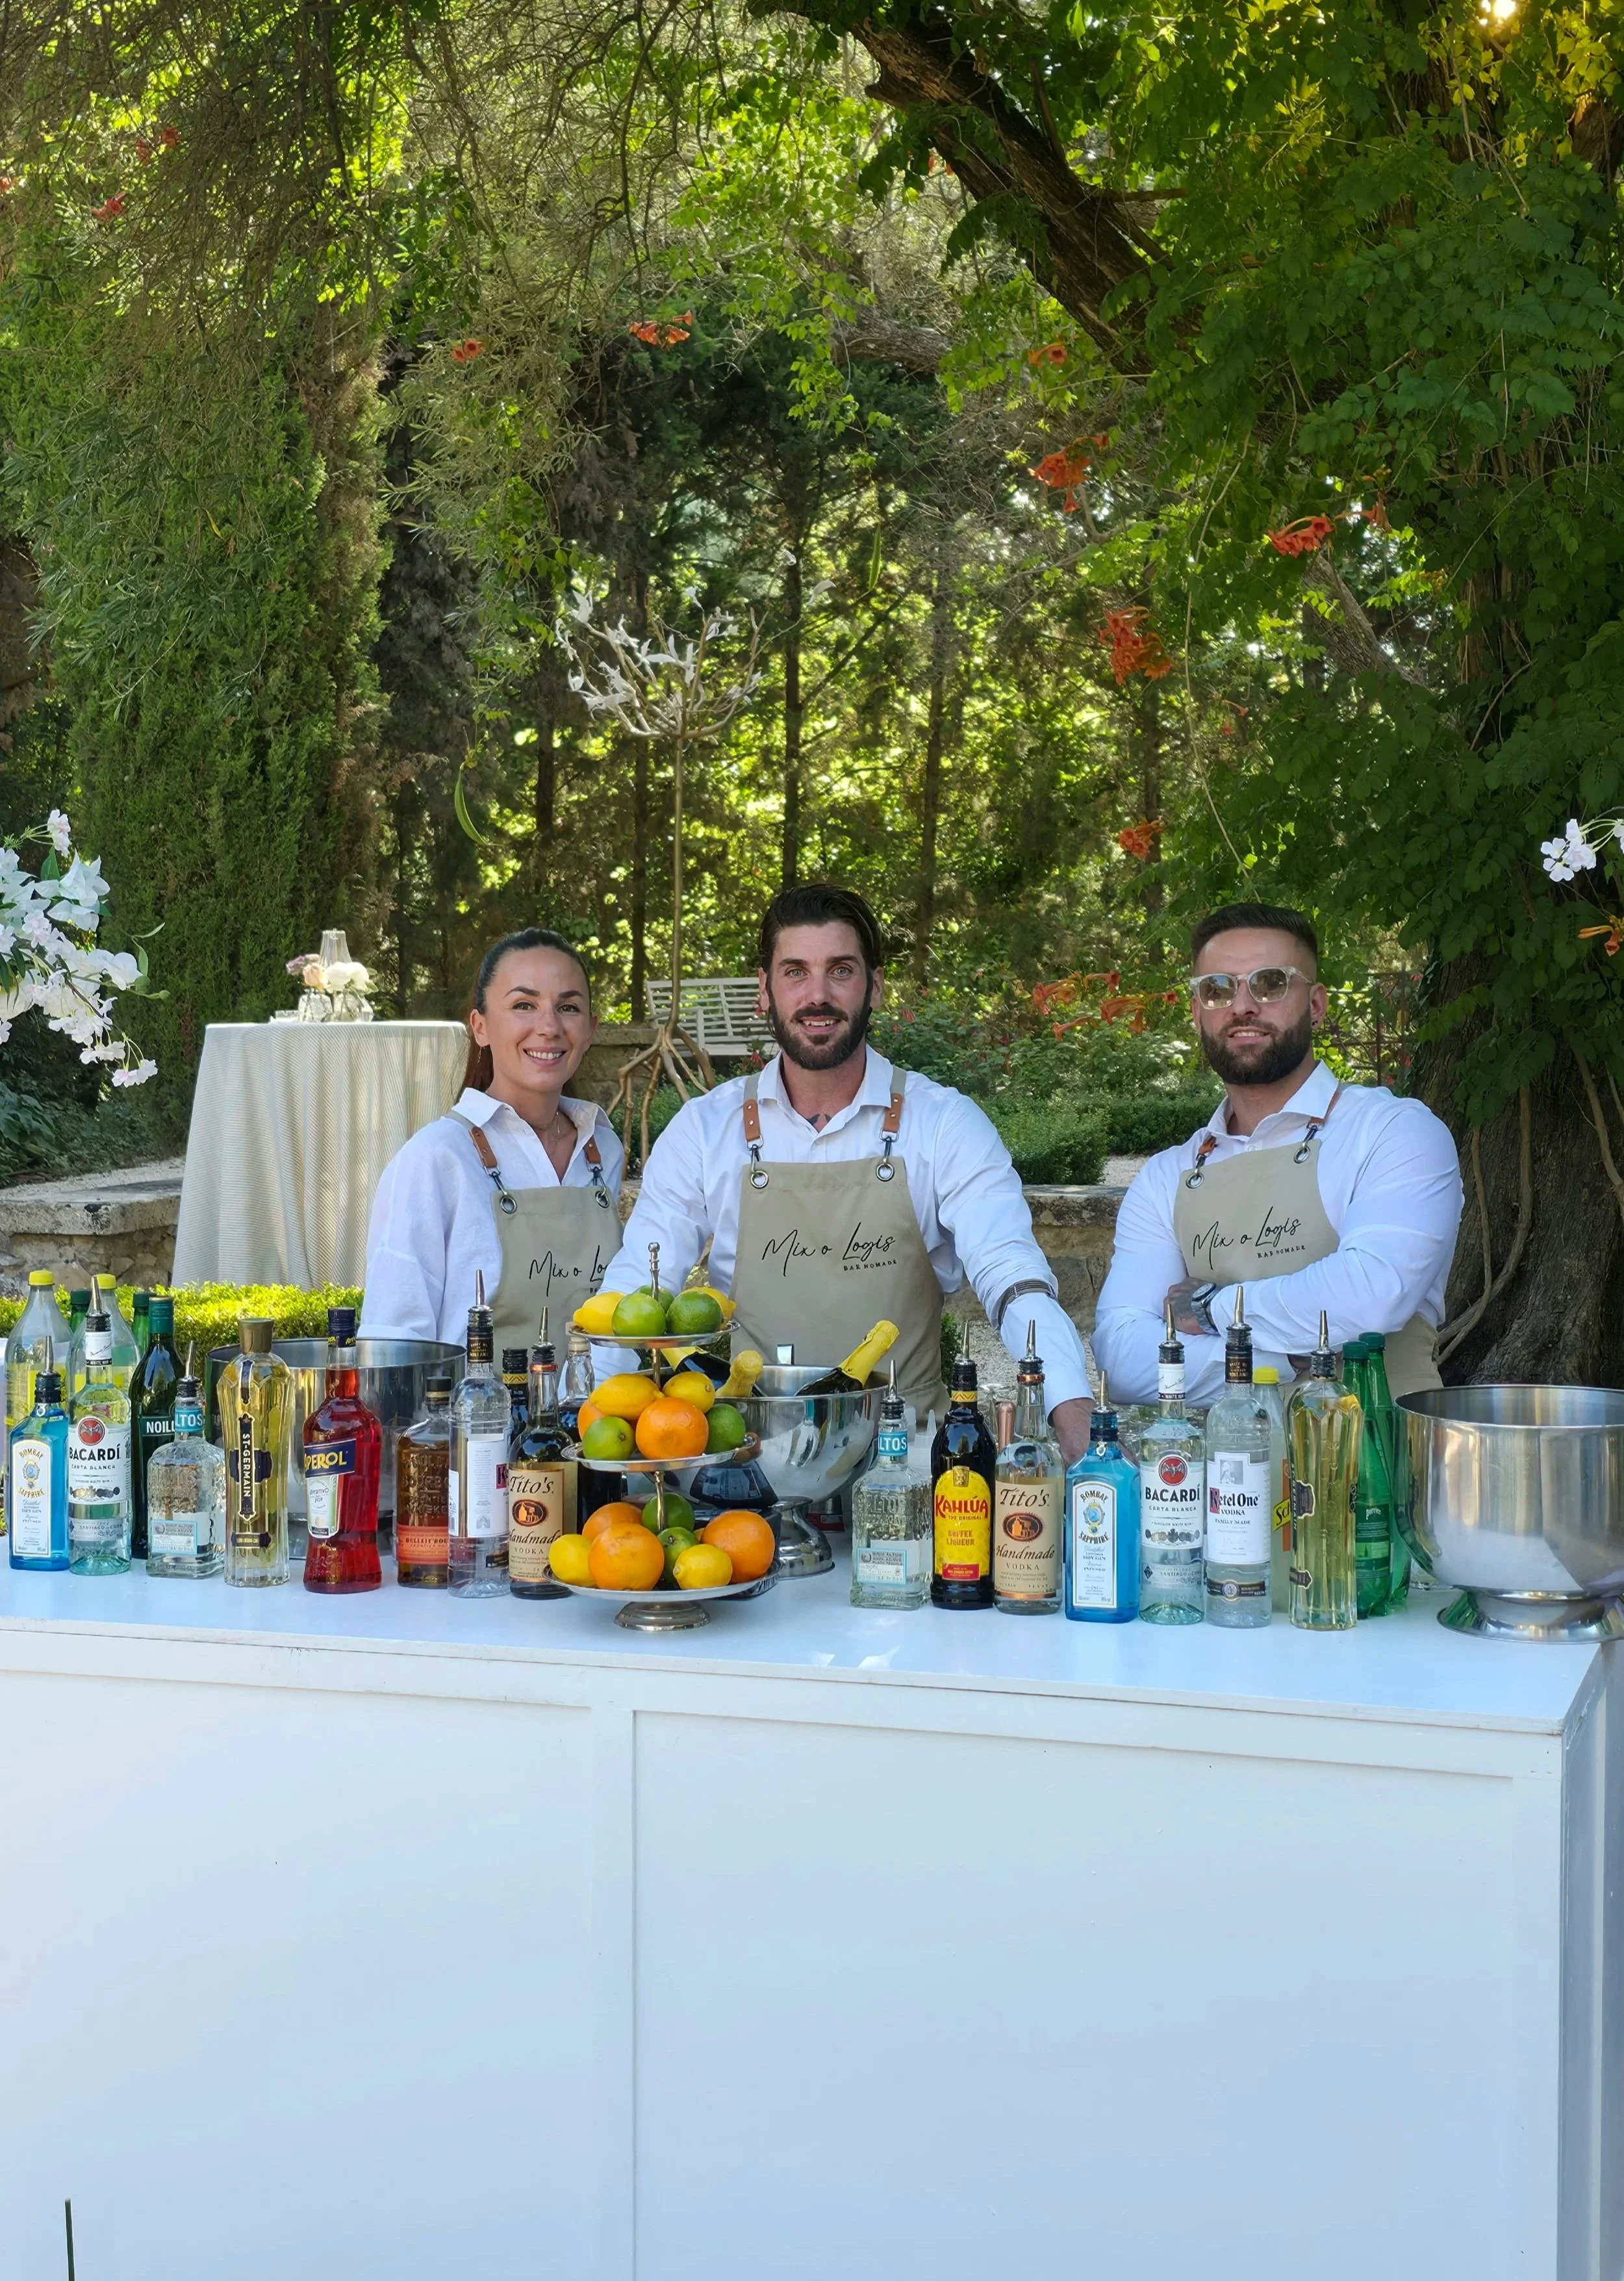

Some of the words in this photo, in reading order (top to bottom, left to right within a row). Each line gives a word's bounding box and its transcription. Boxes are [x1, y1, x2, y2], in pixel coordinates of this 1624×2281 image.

[1193, 1221, 1234, 1271] Mix
[1240, 1234, 1252, 1245] o
[1255, 1206, 1302, 1247] Logis
[762, 1229, 816, 1277] Mix
[821, 1245, 832, 1255] o
[842, 1221, 896, 1262] Logis
[1276, 1245, 1306, 1255] NOMADE
[864, 1258, 897, 1269] NOMADE
[529, 1251, 568, 1297] Mix
[573, 1267, 582, 1277] o
[176, 1413, 203, 1427] LTOS
[879, 1436, 907, 1451] LTOS
[19, 1448, 44, 1459] BOMBAY
[69, 1443, 121, 1462] BACARDÍ
[242, 1433, 251, 1497] ST-GERMAIN
[18, 1486, 45, 1498] SAPPHIRE
[509, 1475, 554, 1494] Tito's
[1000, 1487, 1050, 1507] Tito's
[1080, 1489, 1109, 1503] BOMBAY
[1145, 1484, 1200, 1503] BACARDÍ
[1210, 1487, 1236, 1514] Ketel
[1237, 1492, 1259, 1507] One
[935, 1495, 989, 1519] KAHLÚA
[1365, 1507, 1381, 1520] Perrier
[946, 1538, 975, 1546] LIQUEUR
[1078, 1531, 1110, 1544] SAPPHIRE
[996, 1544, 1055, 1560] Handmade
[1006, 1562, 1039, 1570] VODKA
